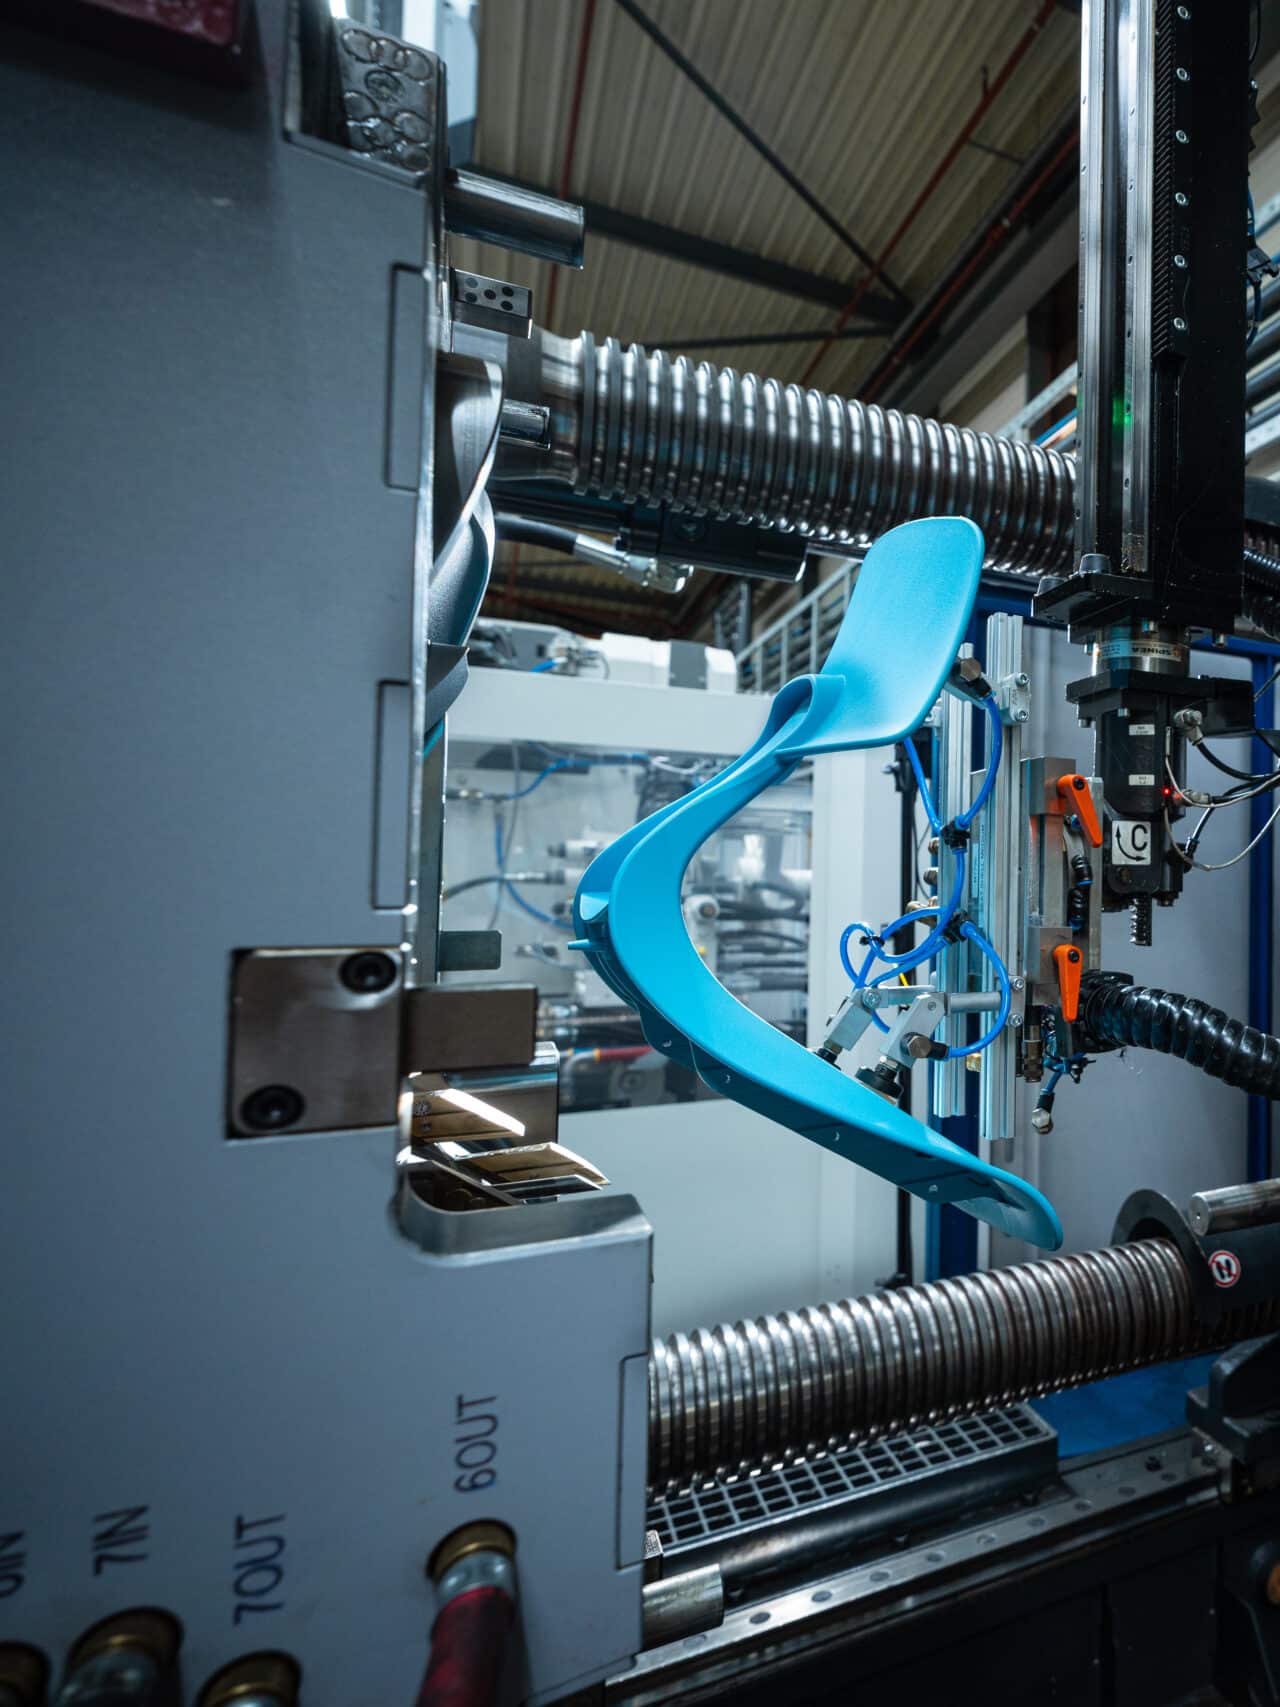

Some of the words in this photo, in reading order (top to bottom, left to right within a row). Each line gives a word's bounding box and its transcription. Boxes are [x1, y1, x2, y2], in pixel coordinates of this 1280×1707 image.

[1132, 824, 1148, 850] C
[455, 1394, 498, 1491] 6OUT
[93, 1506, 149, 1576] 7IN
[233, 1514, 285, 1626] 7OUT
